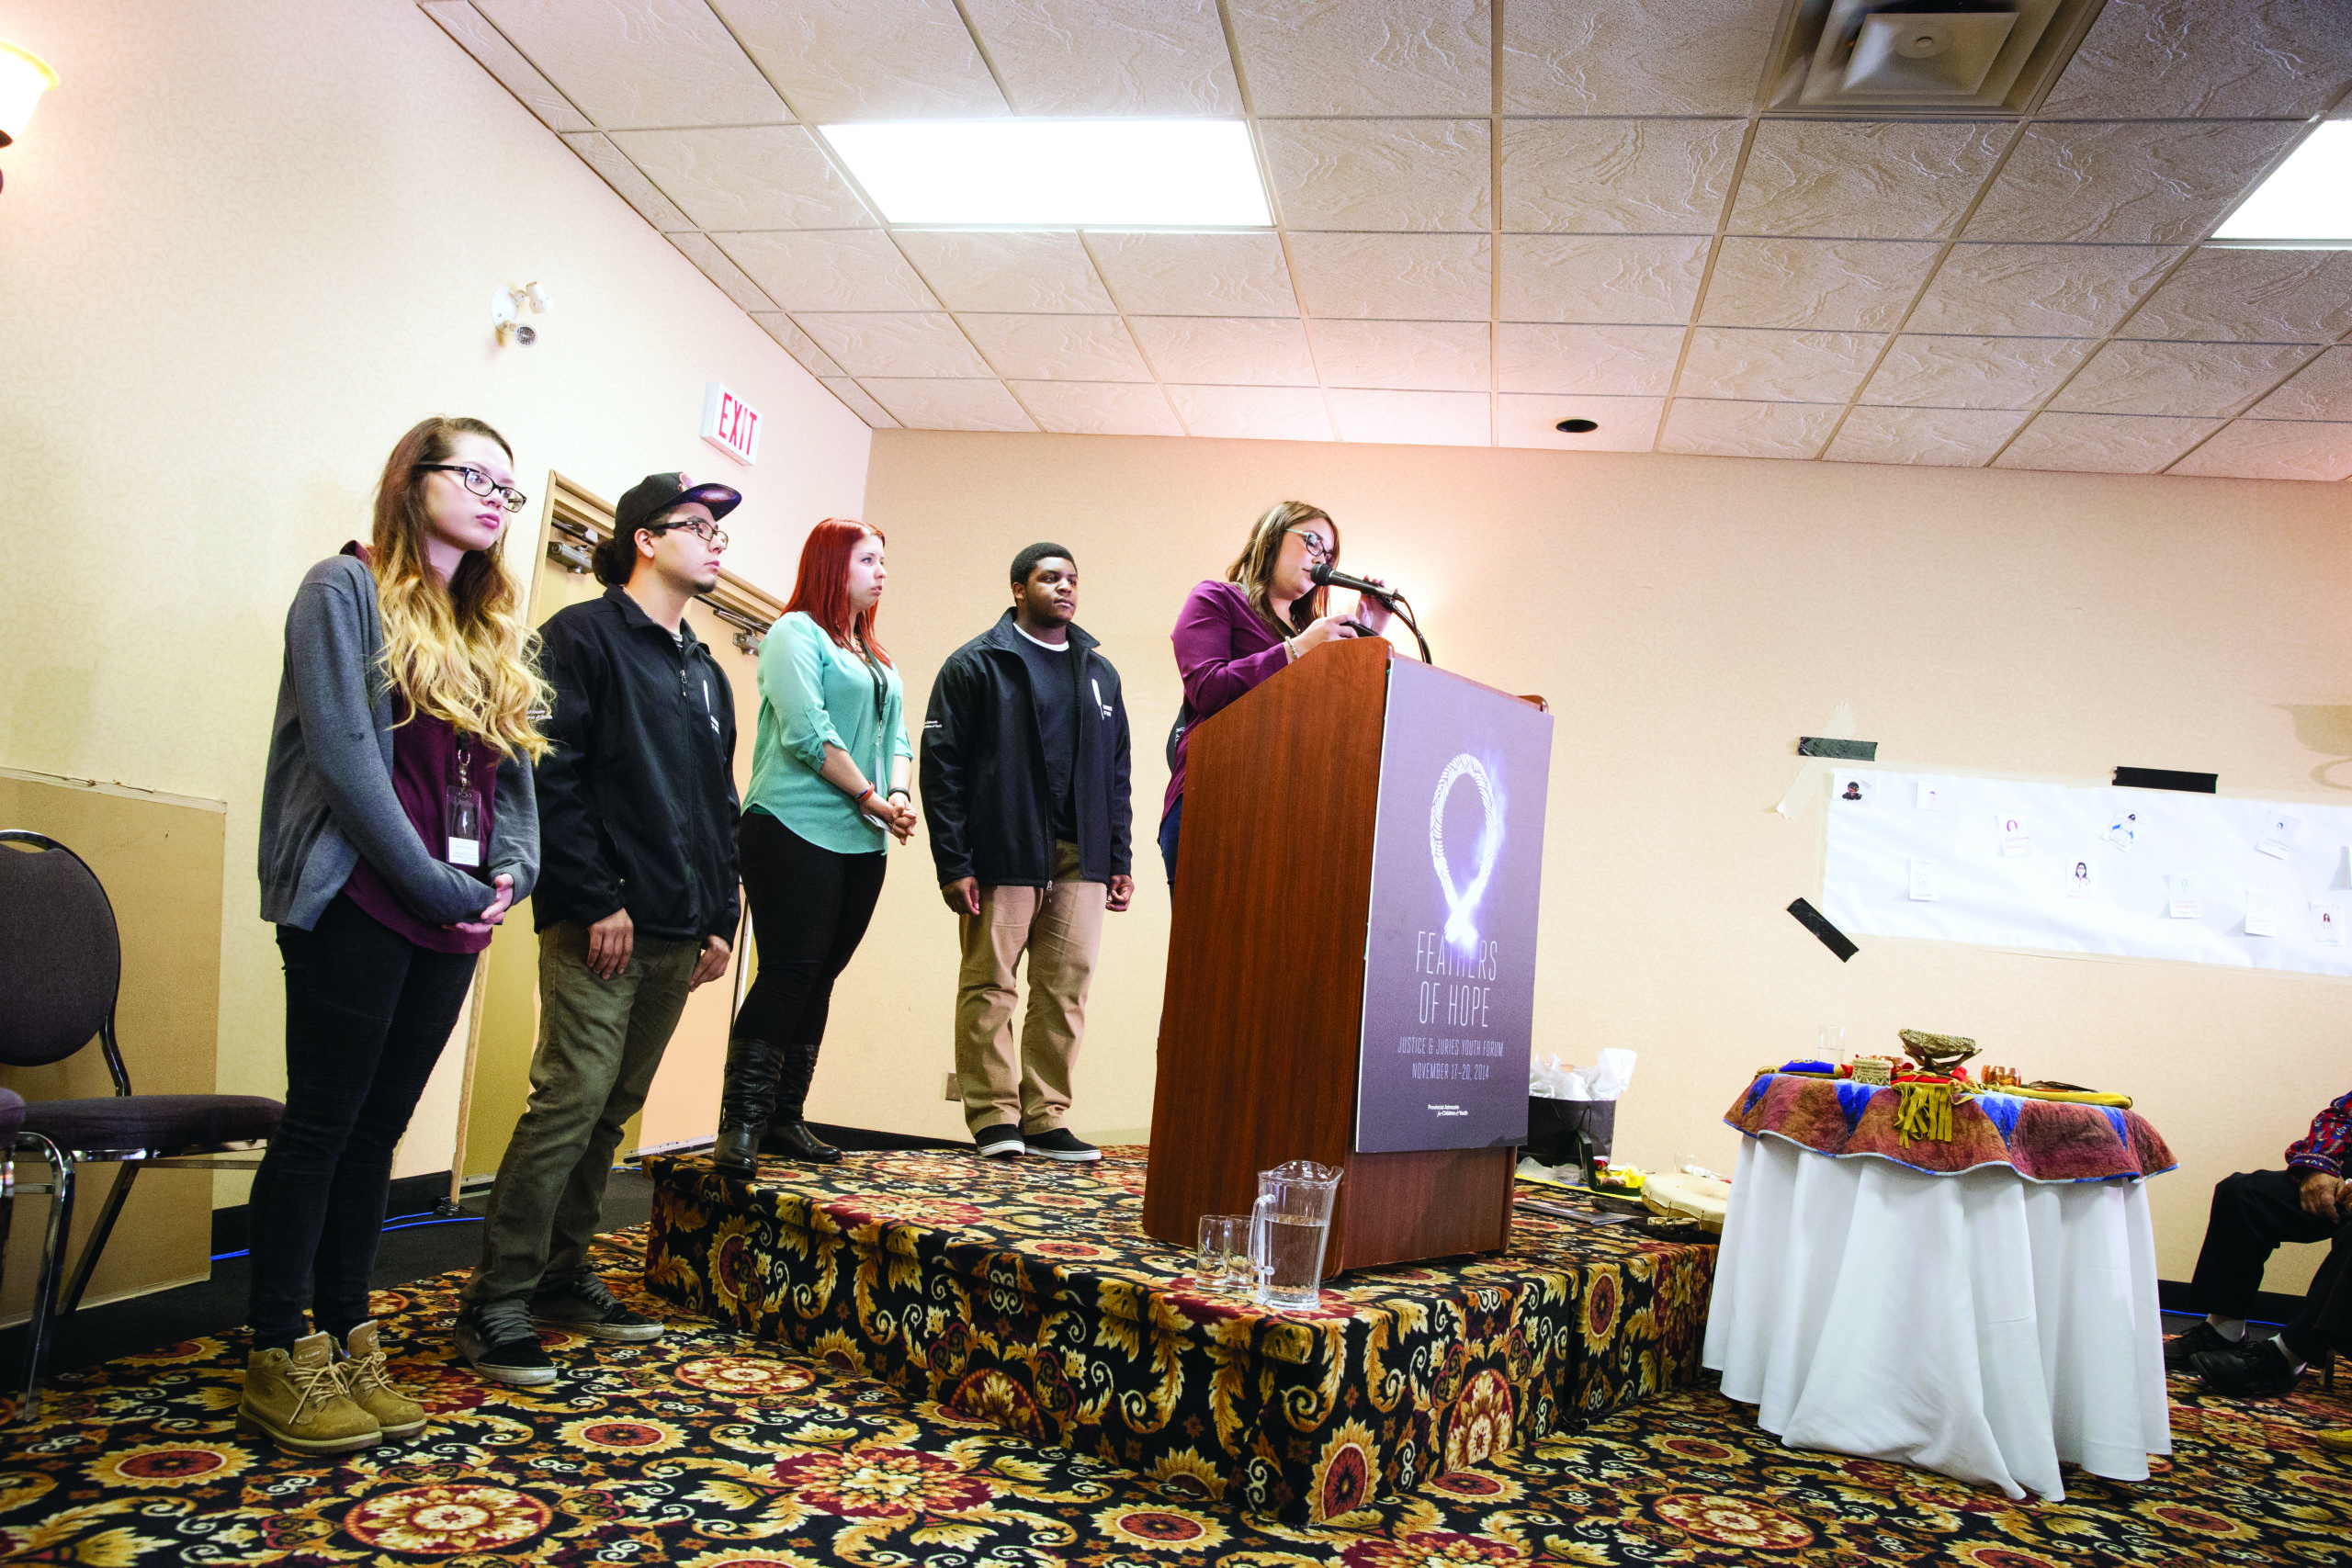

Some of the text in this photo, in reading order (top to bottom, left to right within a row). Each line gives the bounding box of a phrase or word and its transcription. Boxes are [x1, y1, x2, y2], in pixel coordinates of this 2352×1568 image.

[718, 392, 757, 456] EXIT
[1419, 981, 1490, 1028] OF HOPE
[1397, 1036, 1504, 1057] JUSTICE & JURIES YOUTH FORUM
[1412, 1063, 1449, 1080] NOVEMBER
[1474, 1065, 1489, 1081] 2014
